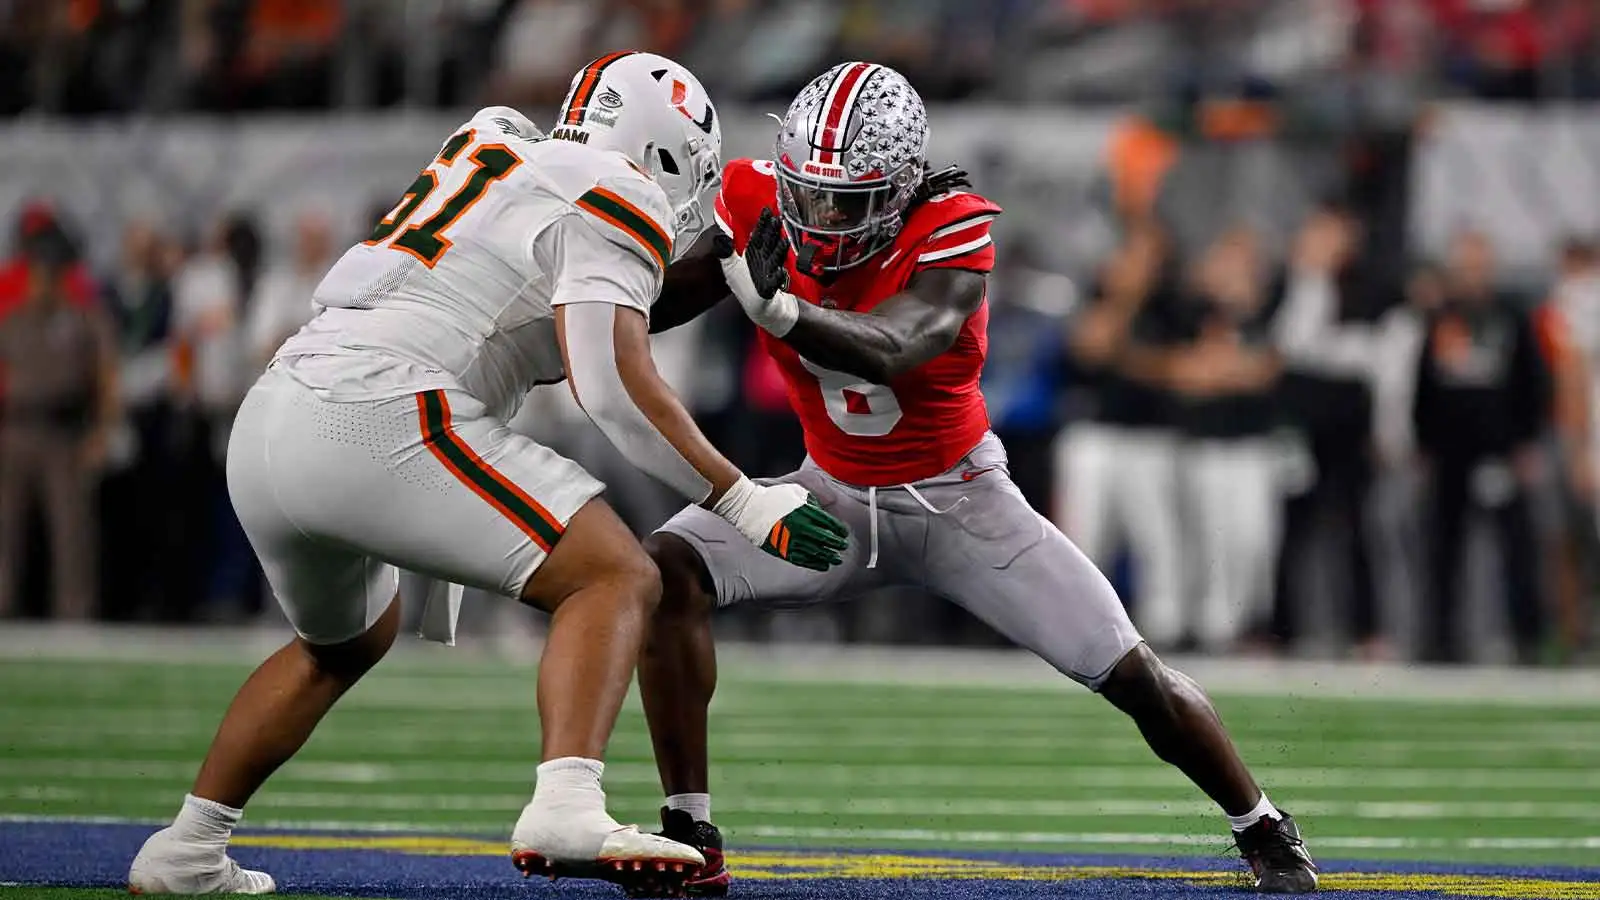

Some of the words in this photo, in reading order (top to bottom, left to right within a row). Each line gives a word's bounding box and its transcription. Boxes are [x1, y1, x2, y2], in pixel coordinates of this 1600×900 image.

[601, 95, 619, 105] ACC
[552, 128, 590, 144] MIAMI
[805, 164, 820, 175] OHIO
[822, 168, 842, 178] STATE
[362, 127, 524, 270] 61
[798, 354, 904, 437] 6
